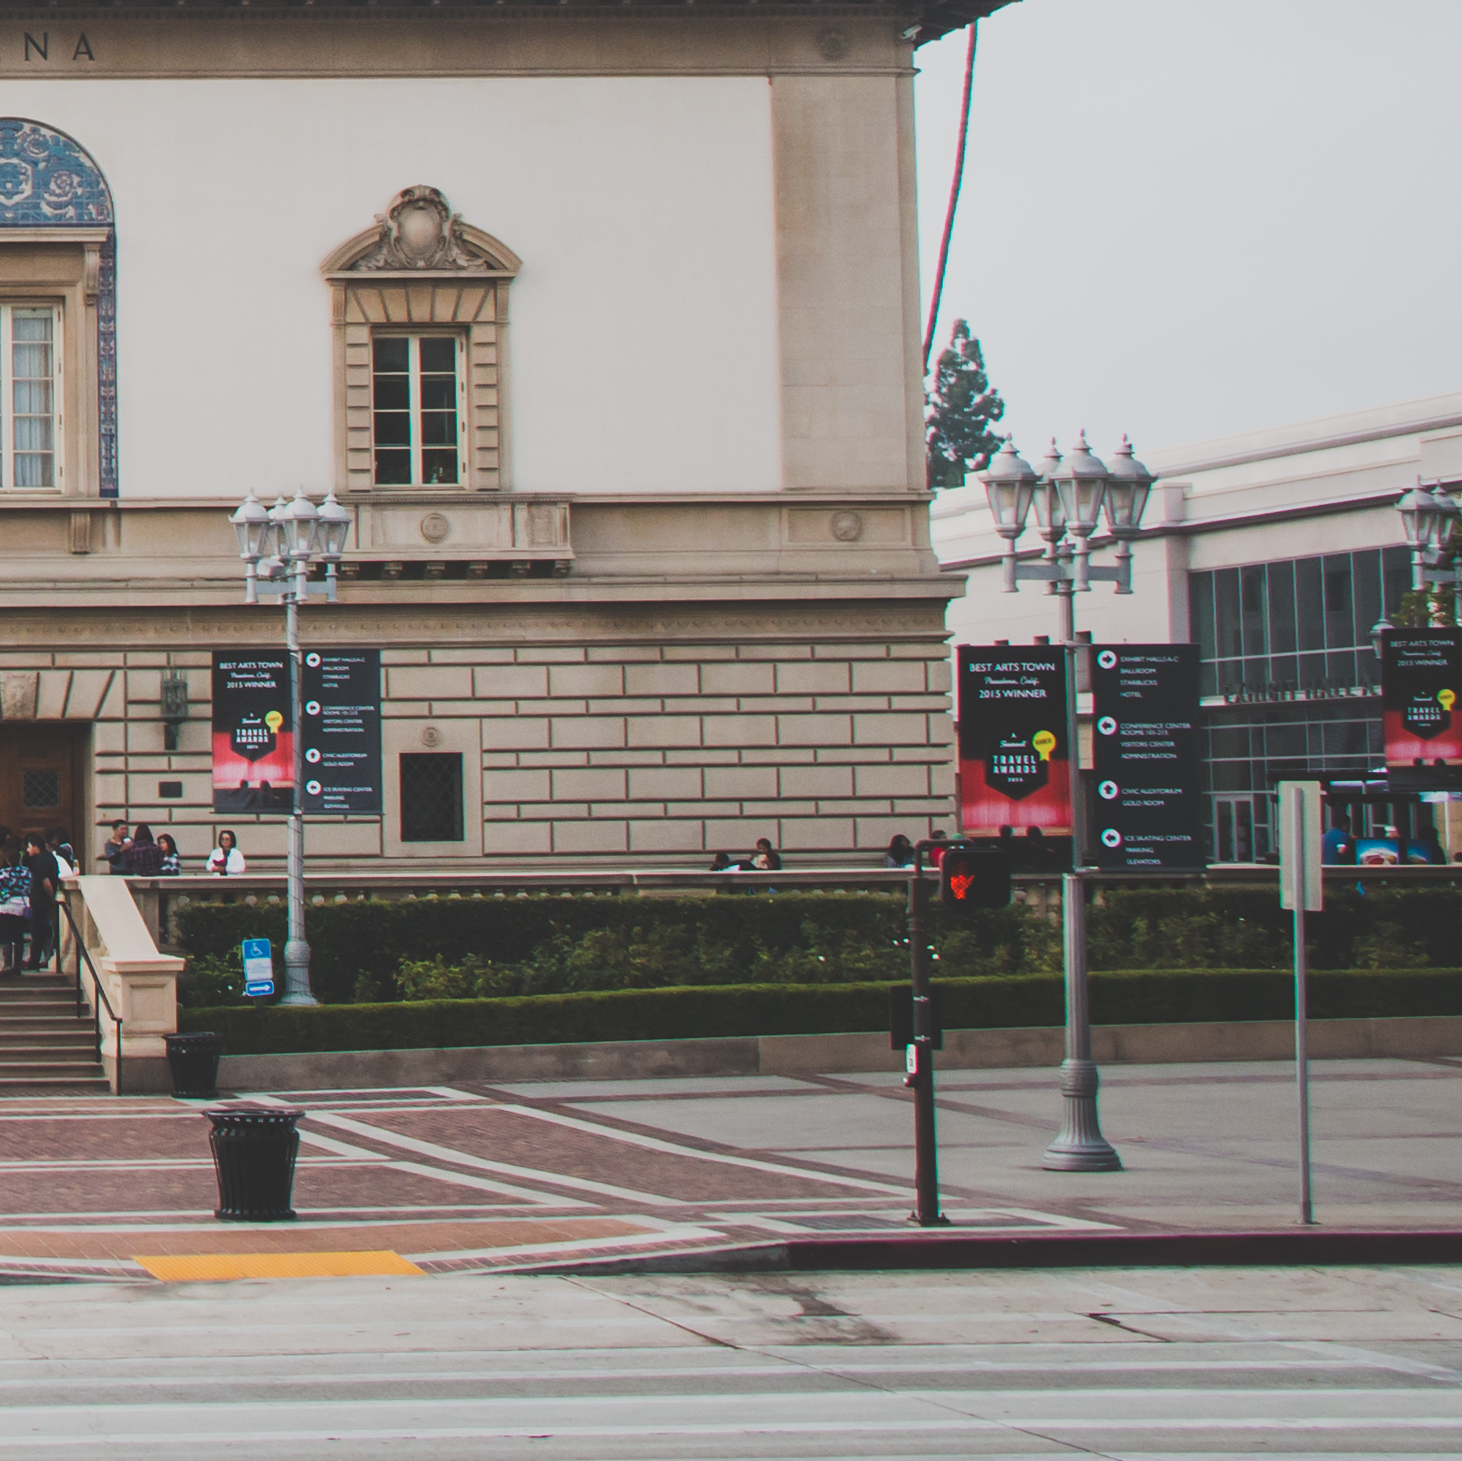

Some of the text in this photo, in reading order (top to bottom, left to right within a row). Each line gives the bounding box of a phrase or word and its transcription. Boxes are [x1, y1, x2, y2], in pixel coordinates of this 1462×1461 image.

[969, 663, 1056, 672] BEST ARTS TOWN
[979, 689, 1048, 698] 2015 WINNER
[993, 755, 1037, 764] TRAVEL
[993, 765, 1037, 774] AWARDS
